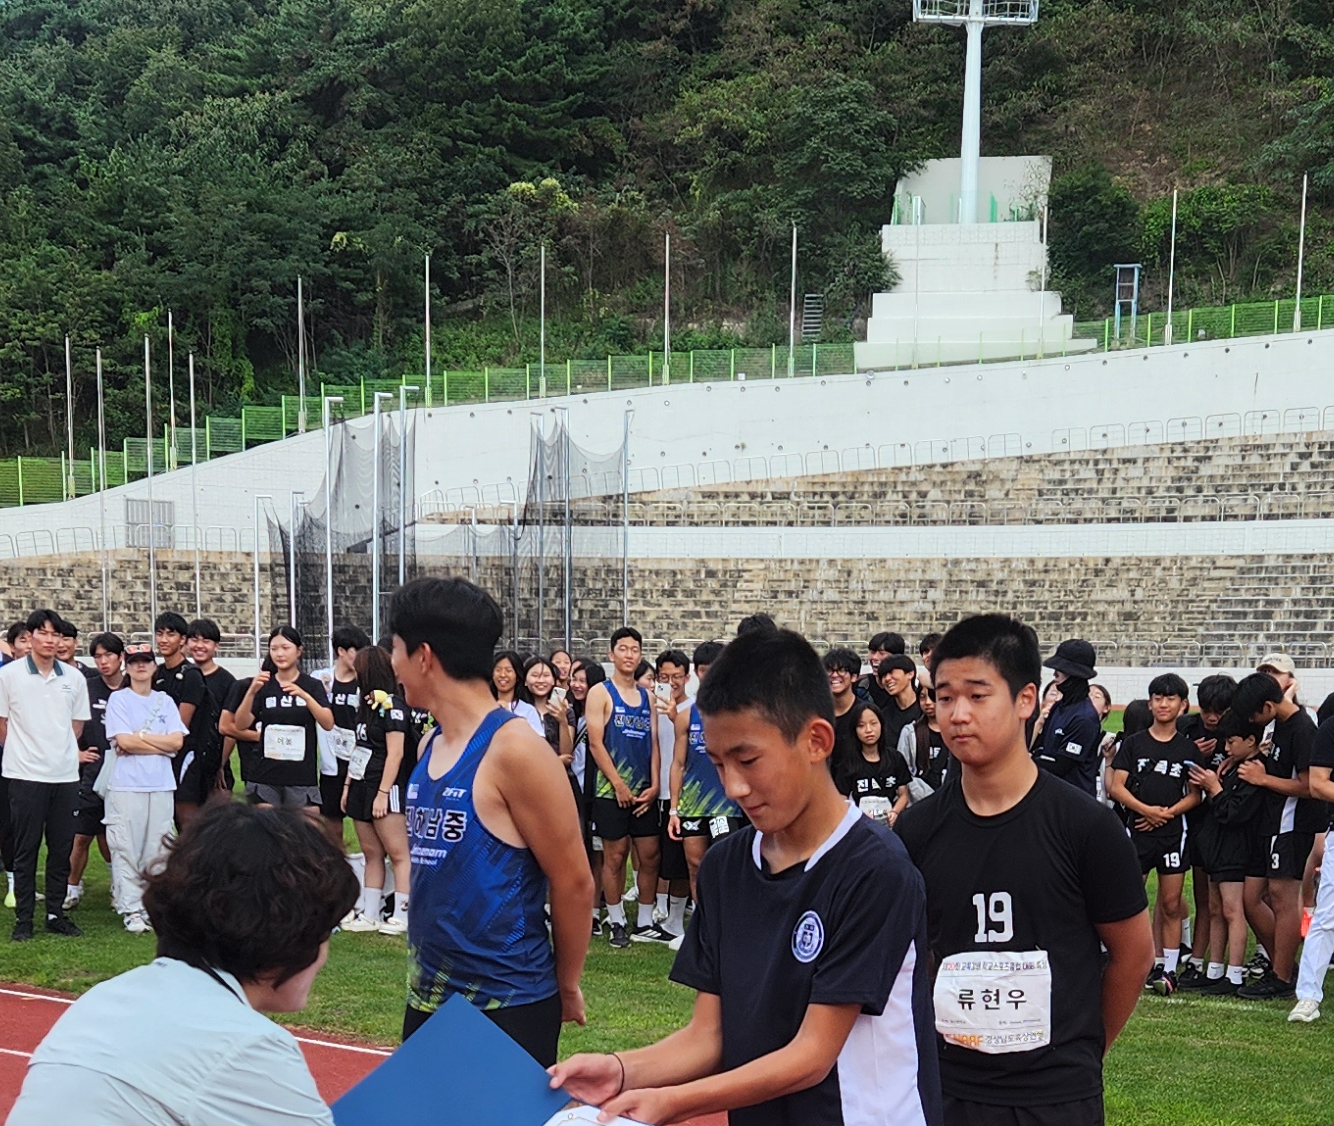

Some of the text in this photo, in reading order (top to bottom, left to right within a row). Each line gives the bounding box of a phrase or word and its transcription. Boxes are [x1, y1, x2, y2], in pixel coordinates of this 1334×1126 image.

[1163, 852, 1181, 868] 19
[972, 891, 1014, 943] 19
[957, 988, 1027, 1010] 류현우
